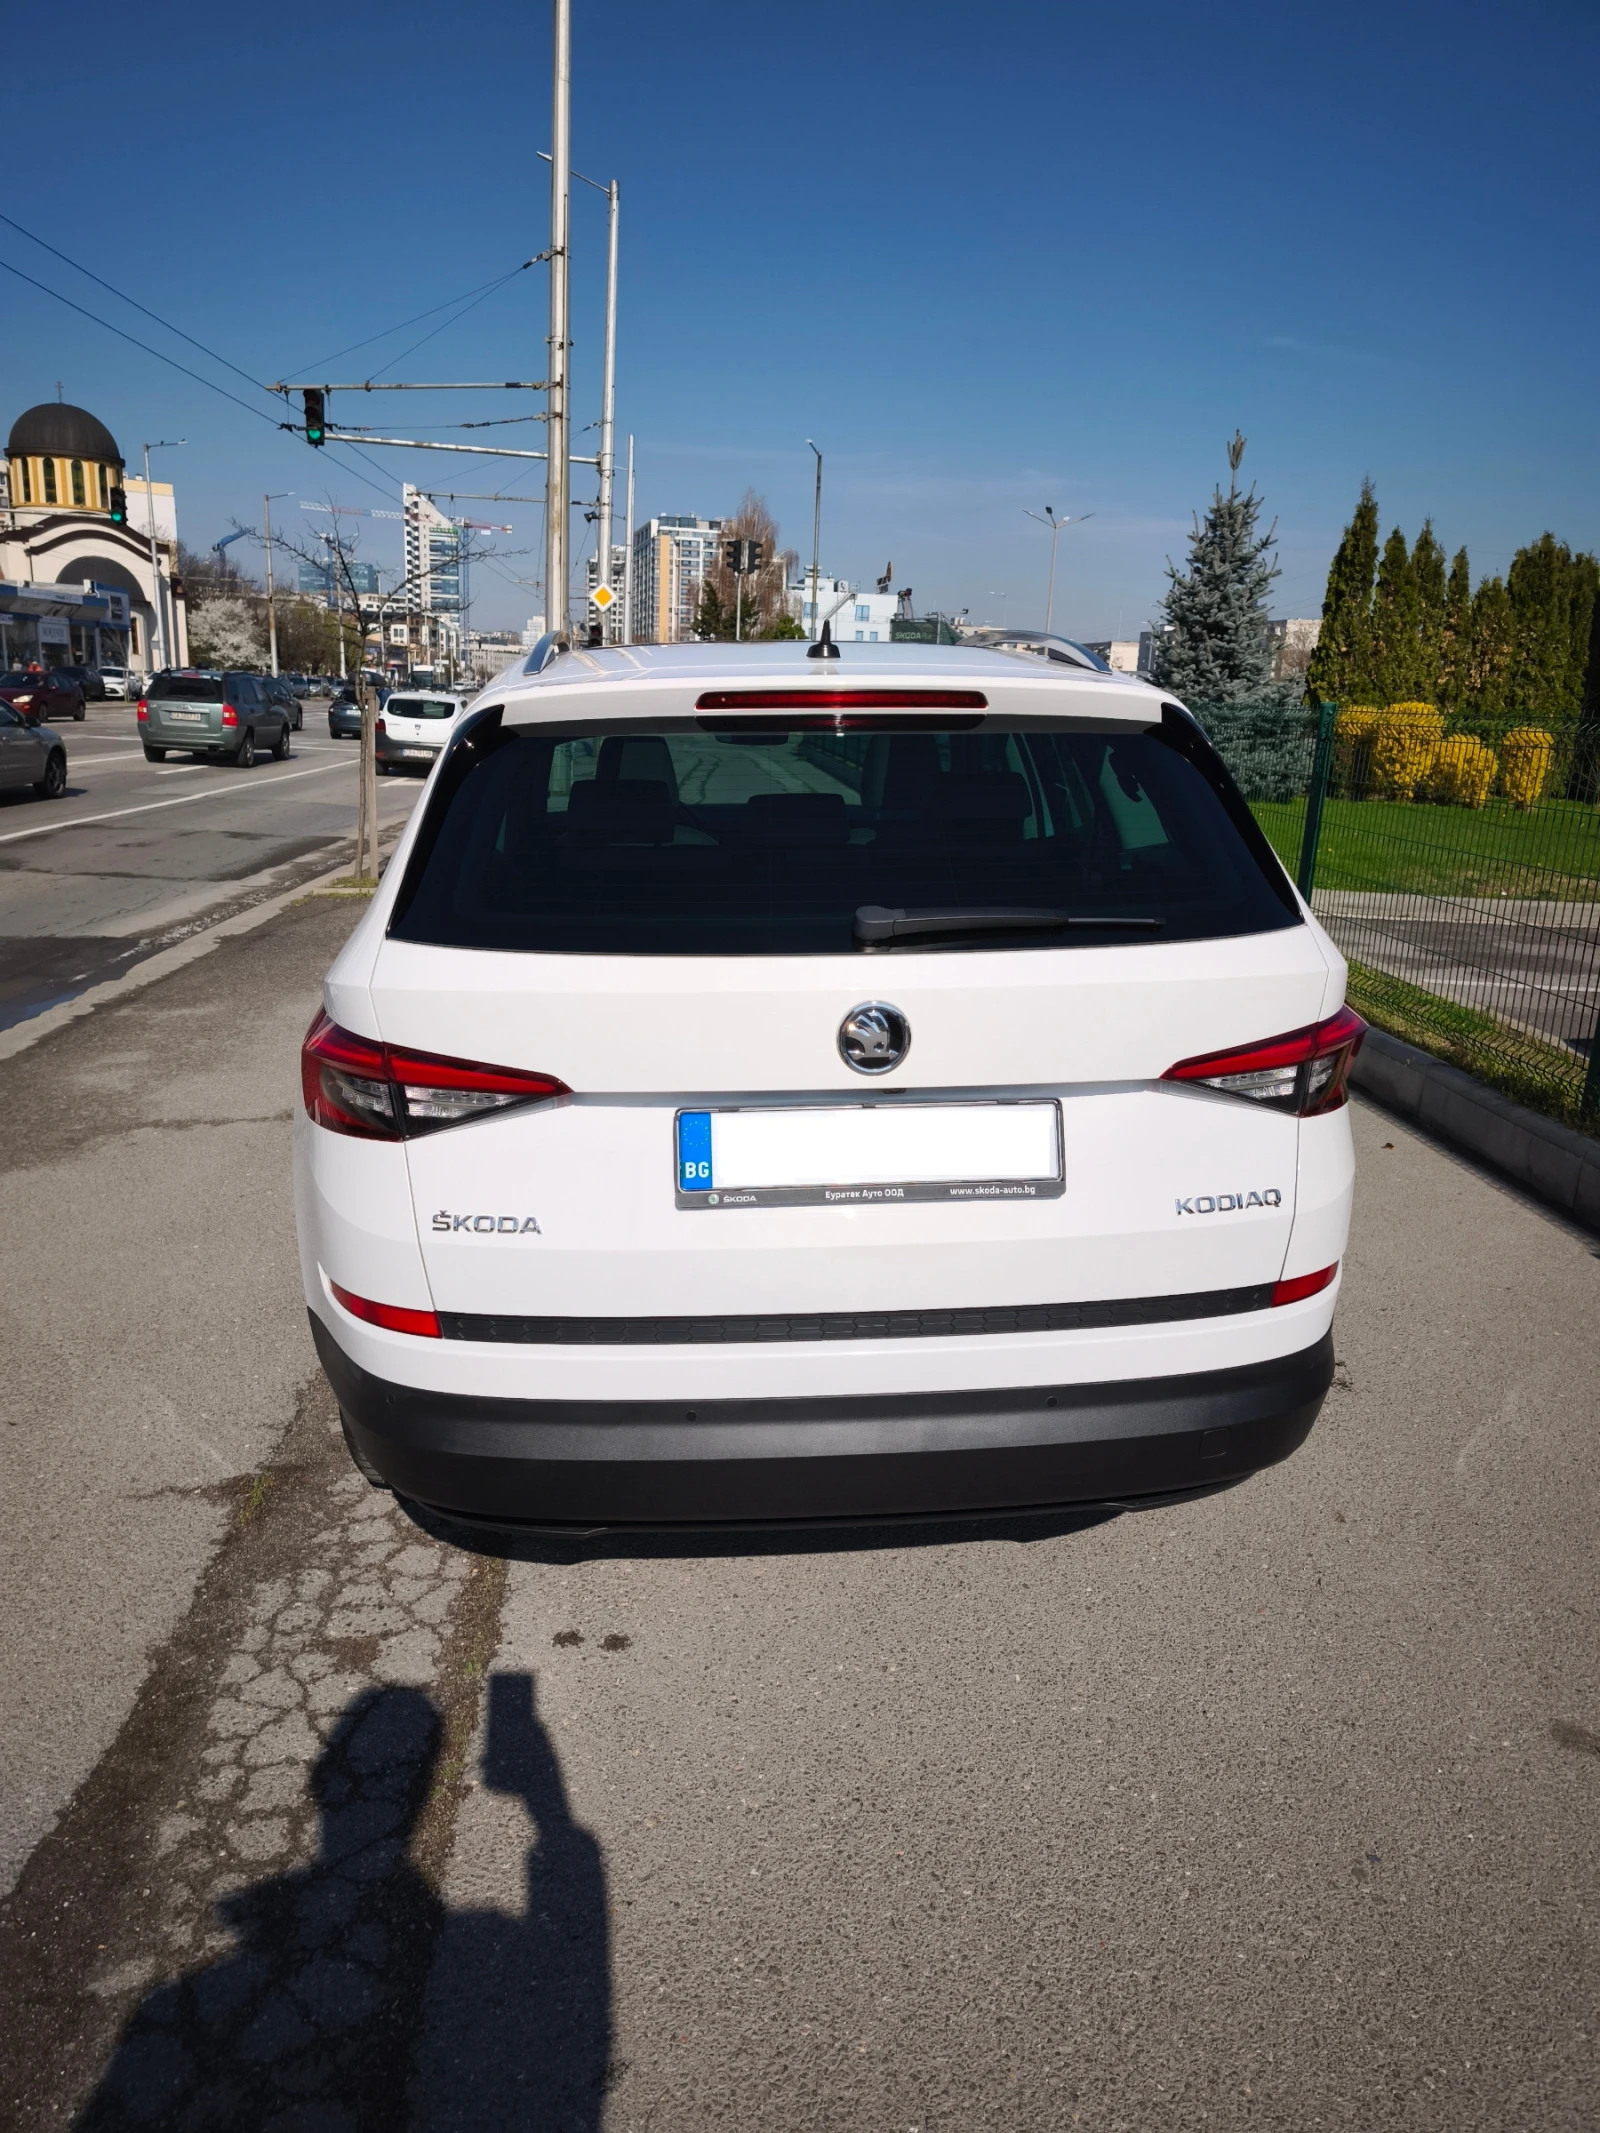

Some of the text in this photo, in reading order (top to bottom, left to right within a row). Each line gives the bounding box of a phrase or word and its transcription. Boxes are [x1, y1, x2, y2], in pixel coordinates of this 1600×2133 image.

[685, 1161, 710, 1179] BG
[862, 1190, 883, 1199] Ауто
[884, 1189, 904, 1197] ООД
[950, 1185, 1036, 1195] www.skoda-auto.bg
[723, 1195, 757, 1203] ŠKODA
[1174, 1188, 1282, 1215] KODIAQ
[432, 1209, 543, 1235] ŠKODA
